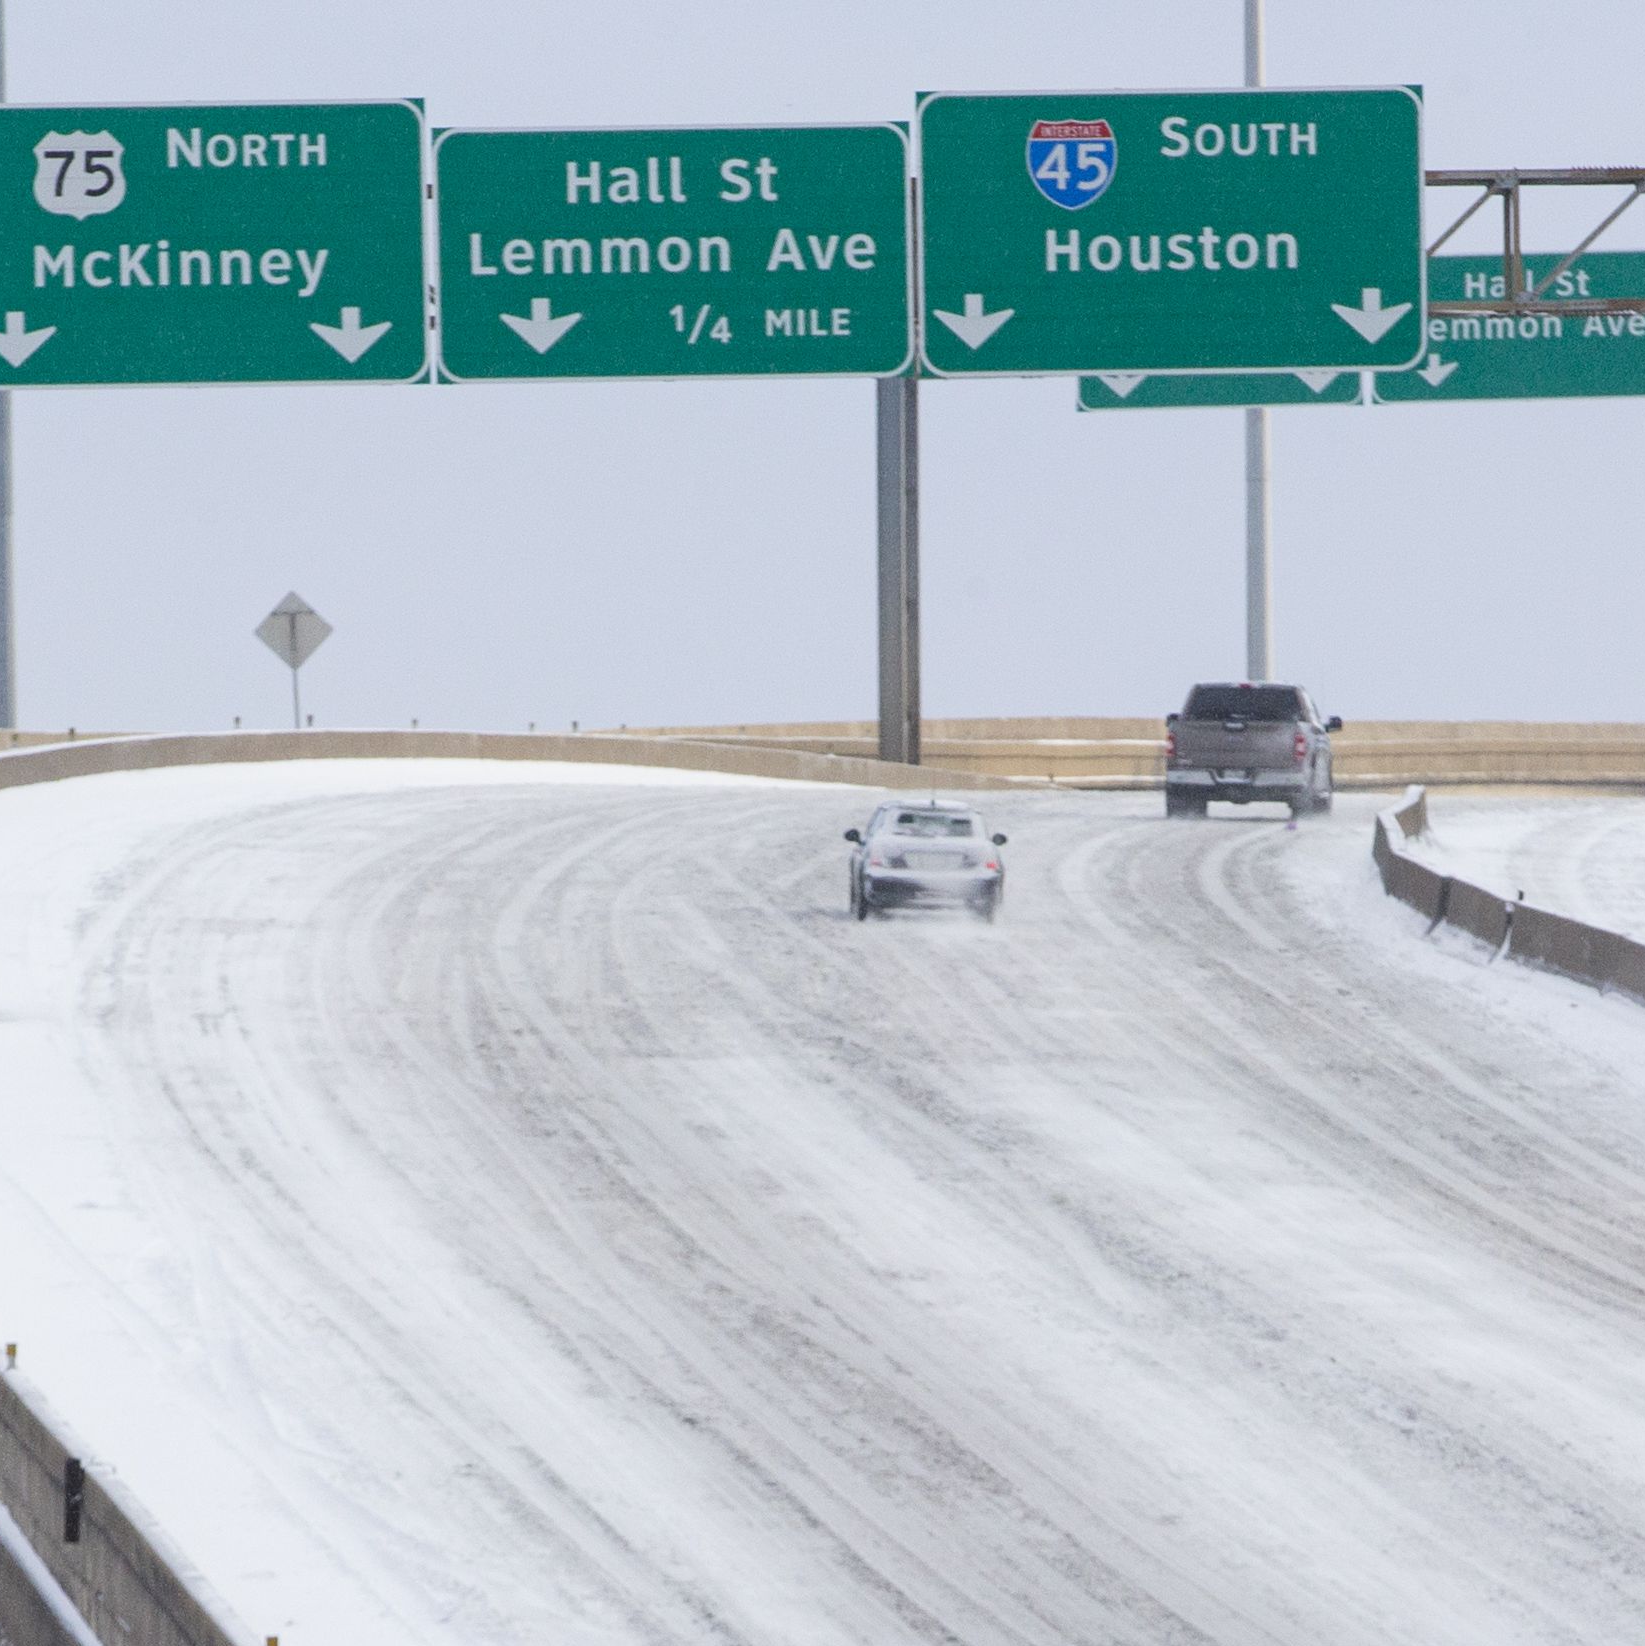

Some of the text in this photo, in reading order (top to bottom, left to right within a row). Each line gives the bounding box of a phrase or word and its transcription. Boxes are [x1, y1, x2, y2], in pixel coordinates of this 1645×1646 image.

[166, 128, 328, 168] NORTH
[1040, 125, 1103, 137] INTERSTATE
[1159, 116, 1319, 158] SOUTH
[44, 149, 115, 198] 75
[566, 157, 779, 204] Hall St
[1036, 142, 1109, 191] 45
[33, 240, 331, 298] McKinney
[469, 229, 877, 276] Lemmon Ave
[1045, 226, 1299, 273] Houston
[1464, 268, 1591, 299] Hal St
[765, 308, 852, 338] MILE
[1428, 315, 1563, 342] emmon
